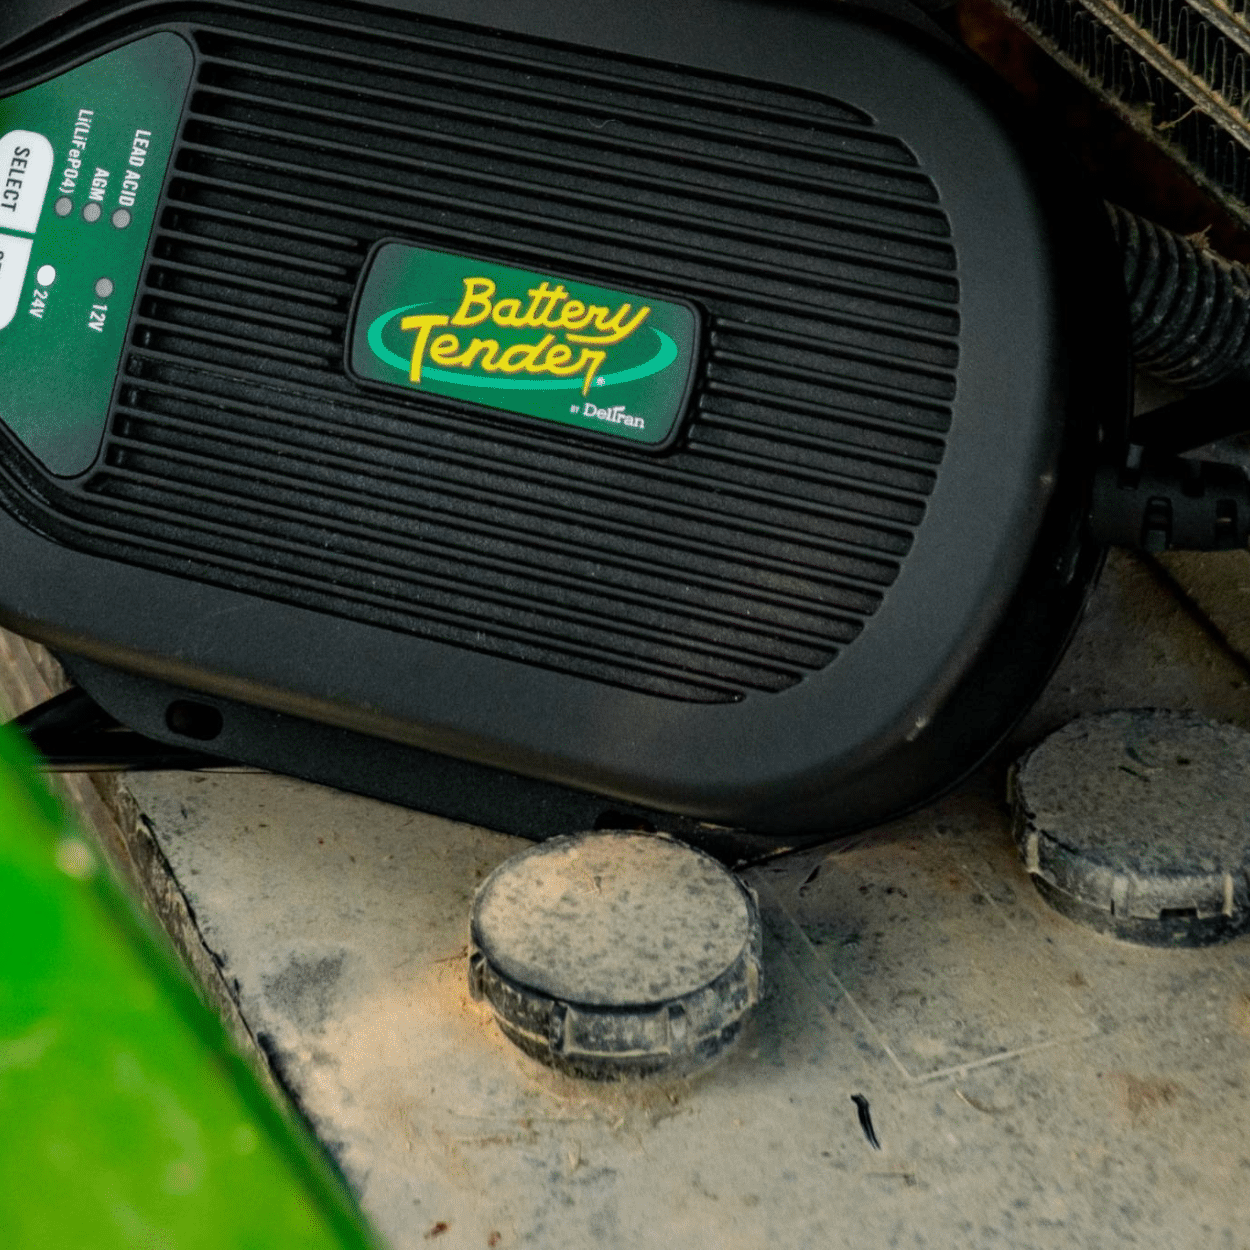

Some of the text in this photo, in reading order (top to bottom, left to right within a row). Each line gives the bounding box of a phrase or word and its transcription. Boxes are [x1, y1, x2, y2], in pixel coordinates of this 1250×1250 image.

[0, 145, 31, 213] SELECT
[88, 166, 110, 202] AGM
[118, 129, 152, 207] LEAD ACID
[29, 289, 49, 319] 24V
[88, 304, 108, 333] 12V
[451, 277, 651, 345] Battery
[400, 314, 607, 397] Tender
